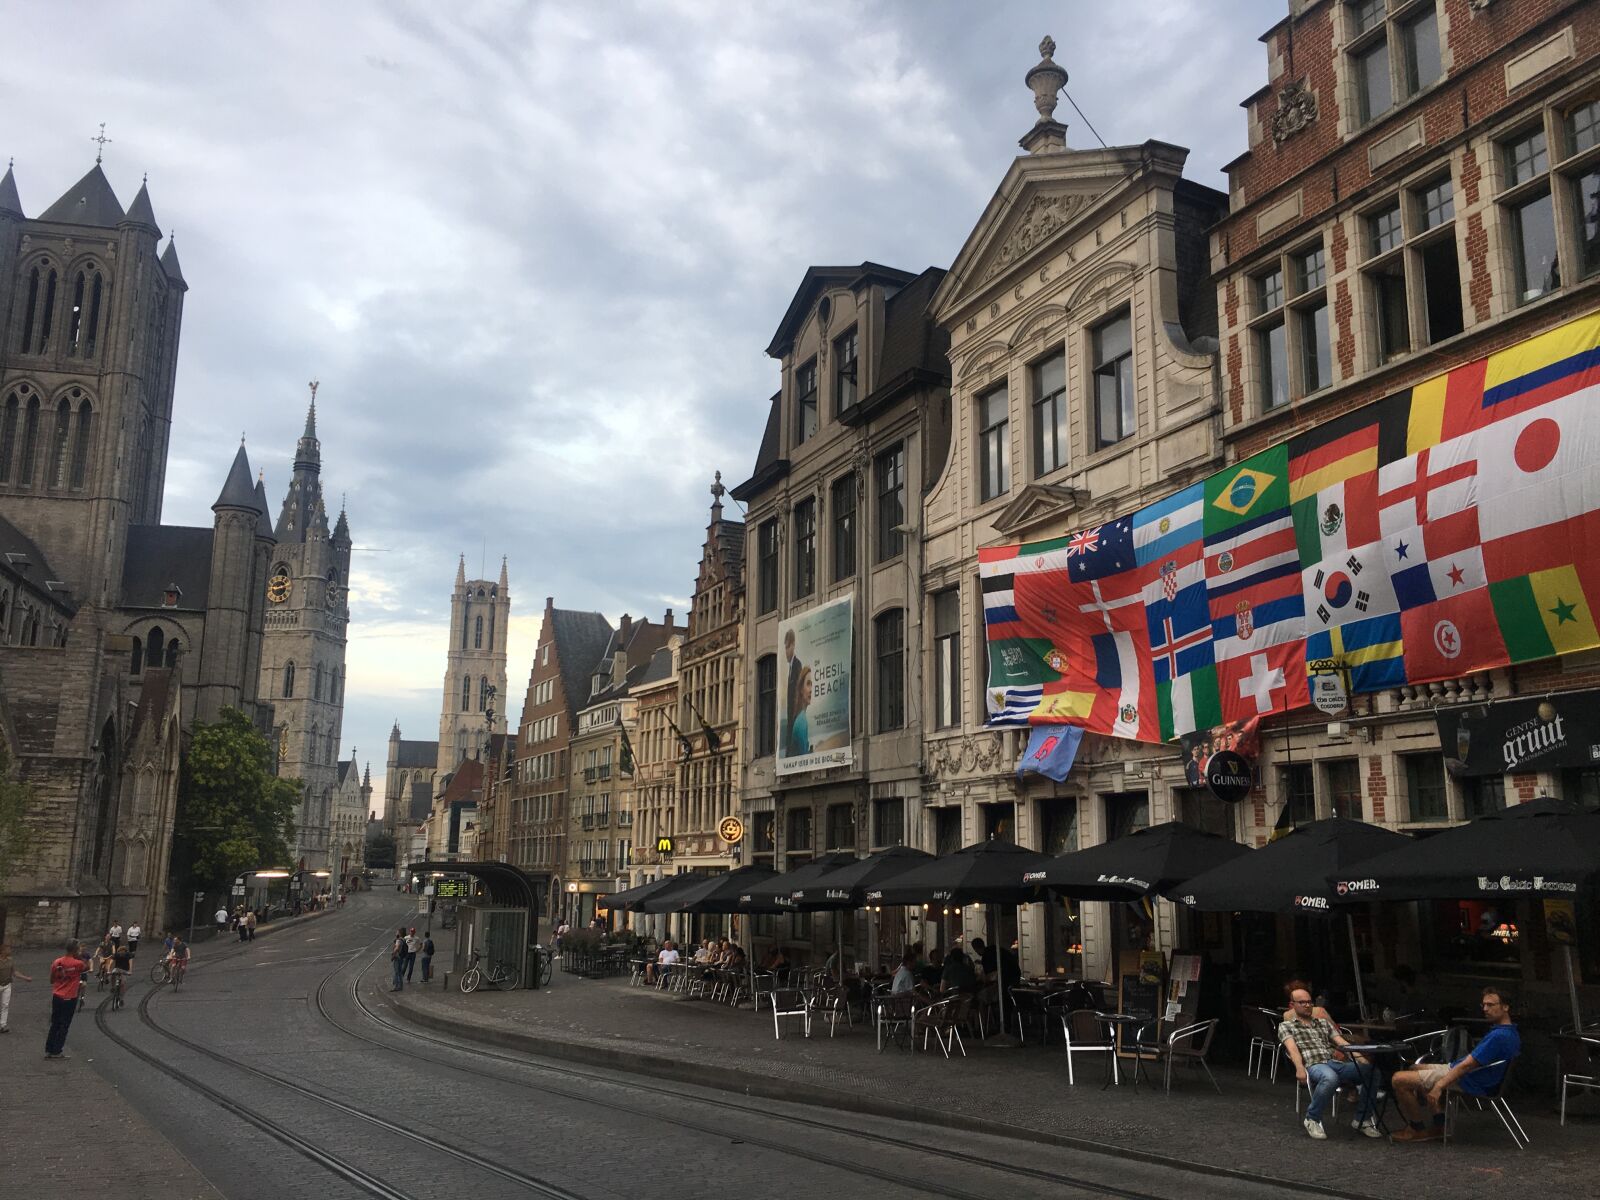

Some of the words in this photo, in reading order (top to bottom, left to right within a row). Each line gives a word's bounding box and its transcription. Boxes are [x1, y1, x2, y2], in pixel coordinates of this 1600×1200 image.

[814, 662, 845, 682] CHESIL
[814, 678, 845, 697] BEACH
[1502, 713, 1566, 771] gruut
[1347, 879, 1380, 891] OMER.
[1301, 896, 1330, 909] OMER.
